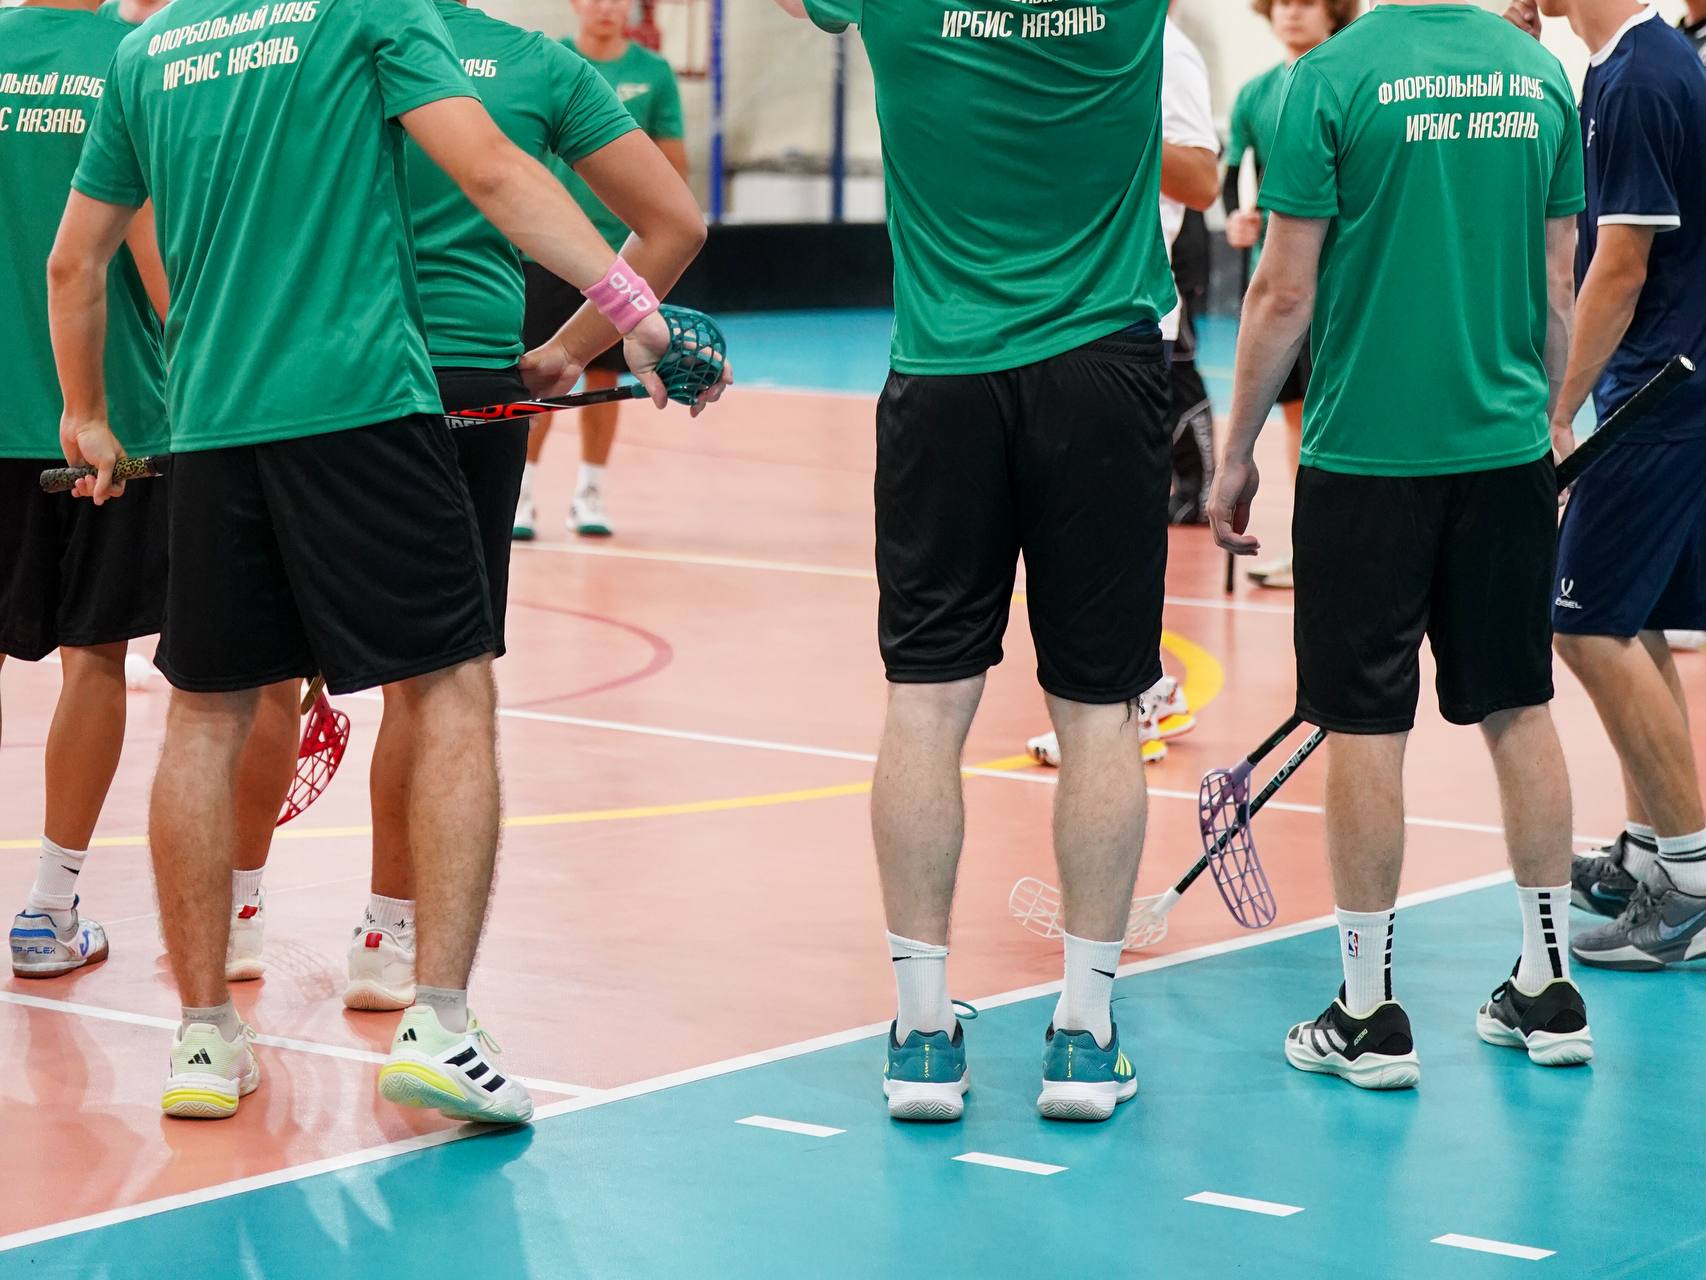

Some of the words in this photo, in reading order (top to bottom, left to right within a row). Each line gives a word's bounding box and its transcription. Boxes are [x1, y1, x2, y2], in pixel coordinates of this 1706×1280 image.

[147, 4, 269, 57] ФЛОРБОЛЬНЫЙ
[269, 0, 320, 26] КЛУБ
[941, 10, 1014, 38] ИРБИС
[1021, 5, 1106, 38] КАЗАНЬ
[163, 51, 222, 91] ИРБИС
[227, 36, 299, 76] КАЗАНЬ
[0, 71, 59, 95] ЛЬНЫЙ
[59, 74, 106, 99] КЛУБ
[1378, 71, 1503, 105] ФЛОРБОЛЬНЫЙ
[1509, 73, 1544, 100] КЛУБ
[15, 107, 87, 134] КАЗАНЬ
[1406, 112, 1462, 142] ИРБИС
[1467, 111, 1539, 139] КАЗАНЬ
